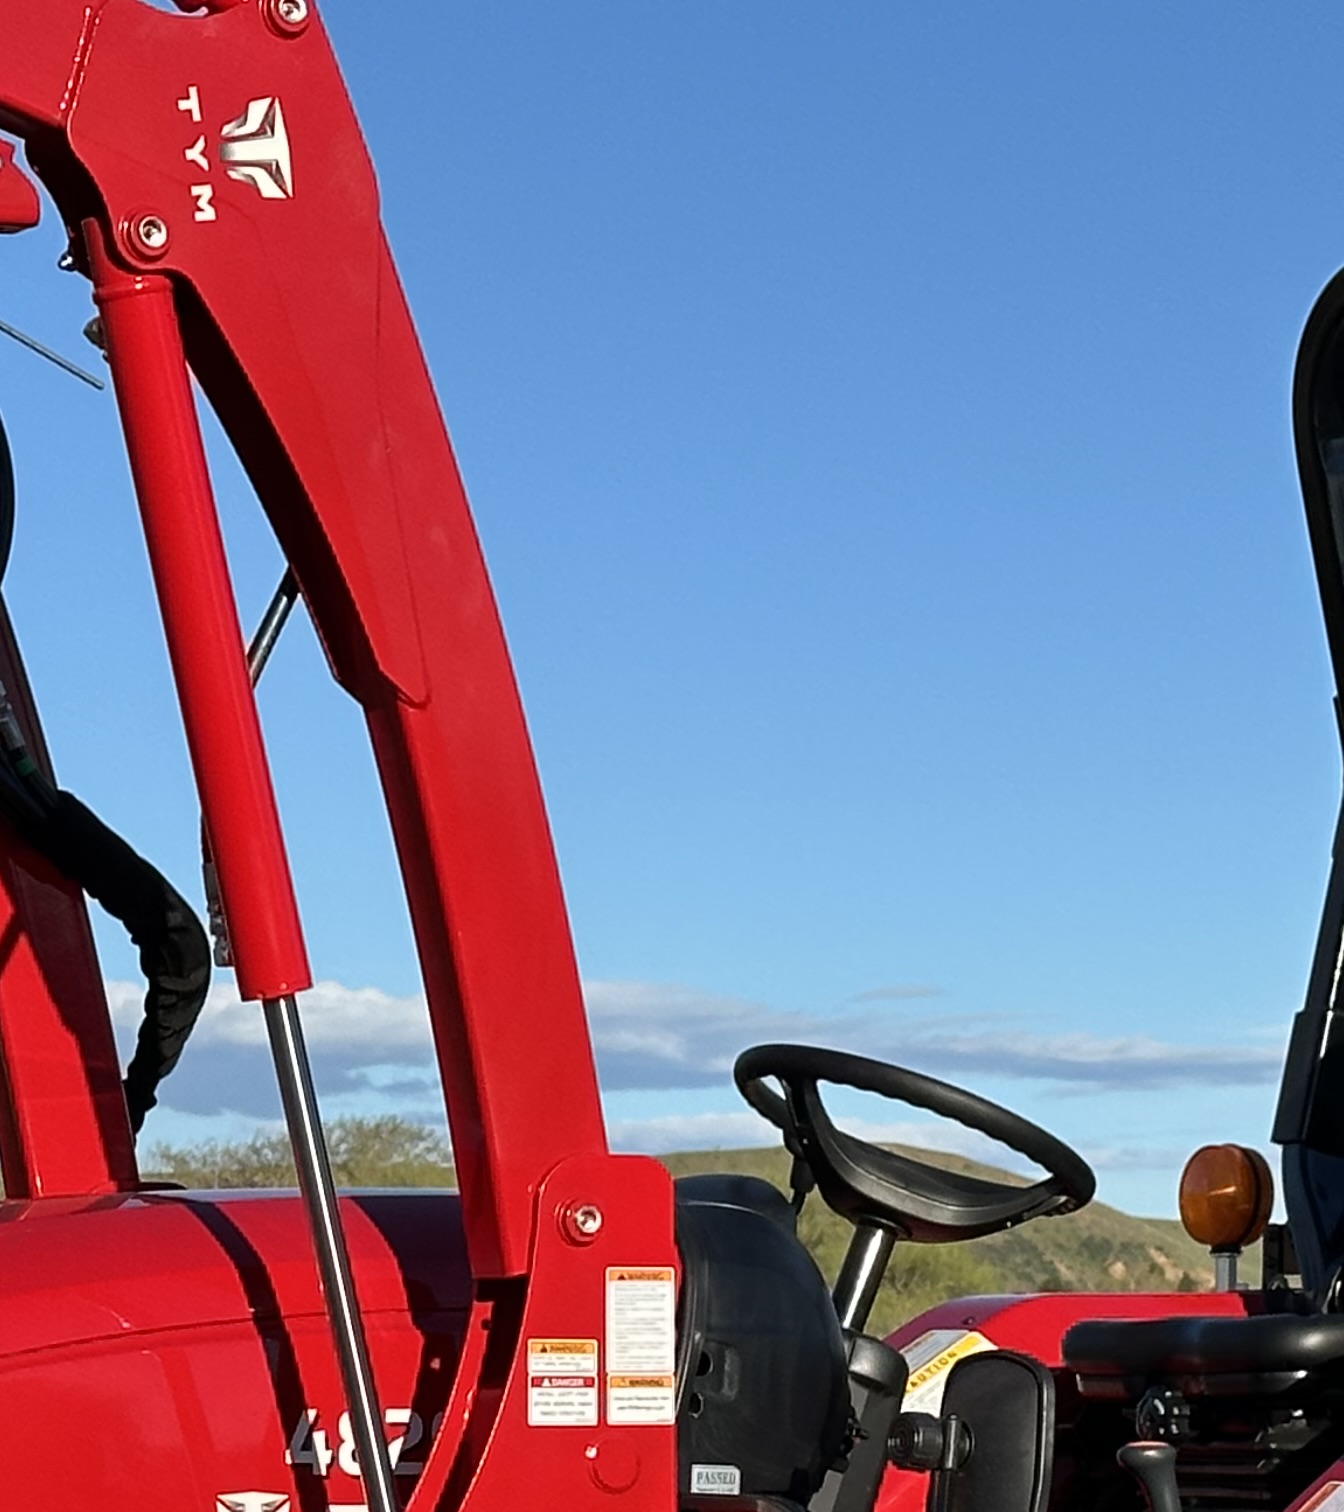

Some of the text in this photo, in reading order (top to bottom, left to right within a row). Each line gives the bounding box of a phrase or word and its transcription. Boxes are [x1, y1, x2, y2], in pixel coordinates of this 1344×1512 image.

[177, 86, 216, 222] TYM
[906, 1352, 958, 1392] AUTION
[285, 1407, 444, 1476] 482
[696, 1471, 736, 1485] PASSED
